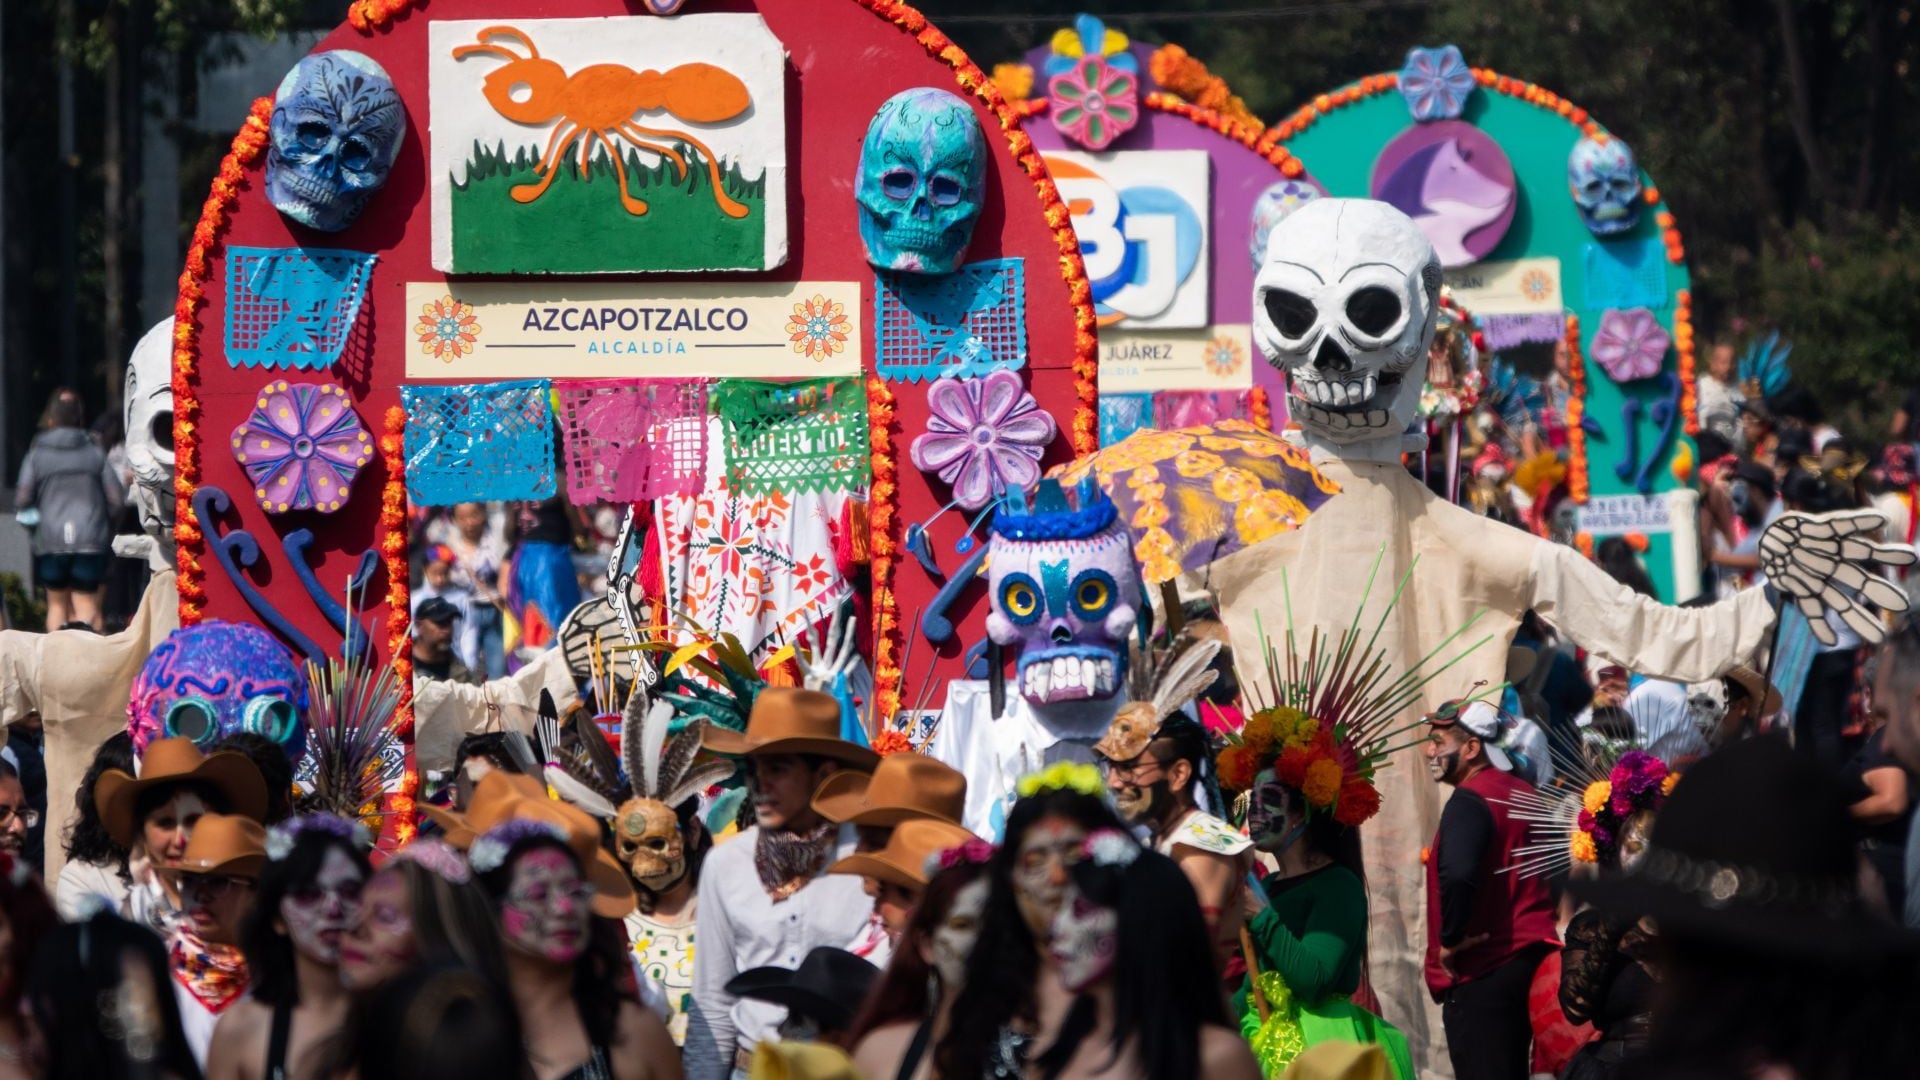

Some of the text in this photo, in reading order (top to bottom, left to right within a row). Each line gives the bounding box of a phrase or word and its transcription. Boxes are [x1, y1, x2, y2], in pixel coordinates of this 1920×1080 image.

[523, 308, 748, 331] AZCAPOTZALCO
[588, 338, 686, 354] ALCALDÍA
[1105, 341, 1173, 361] JUÁREZ
